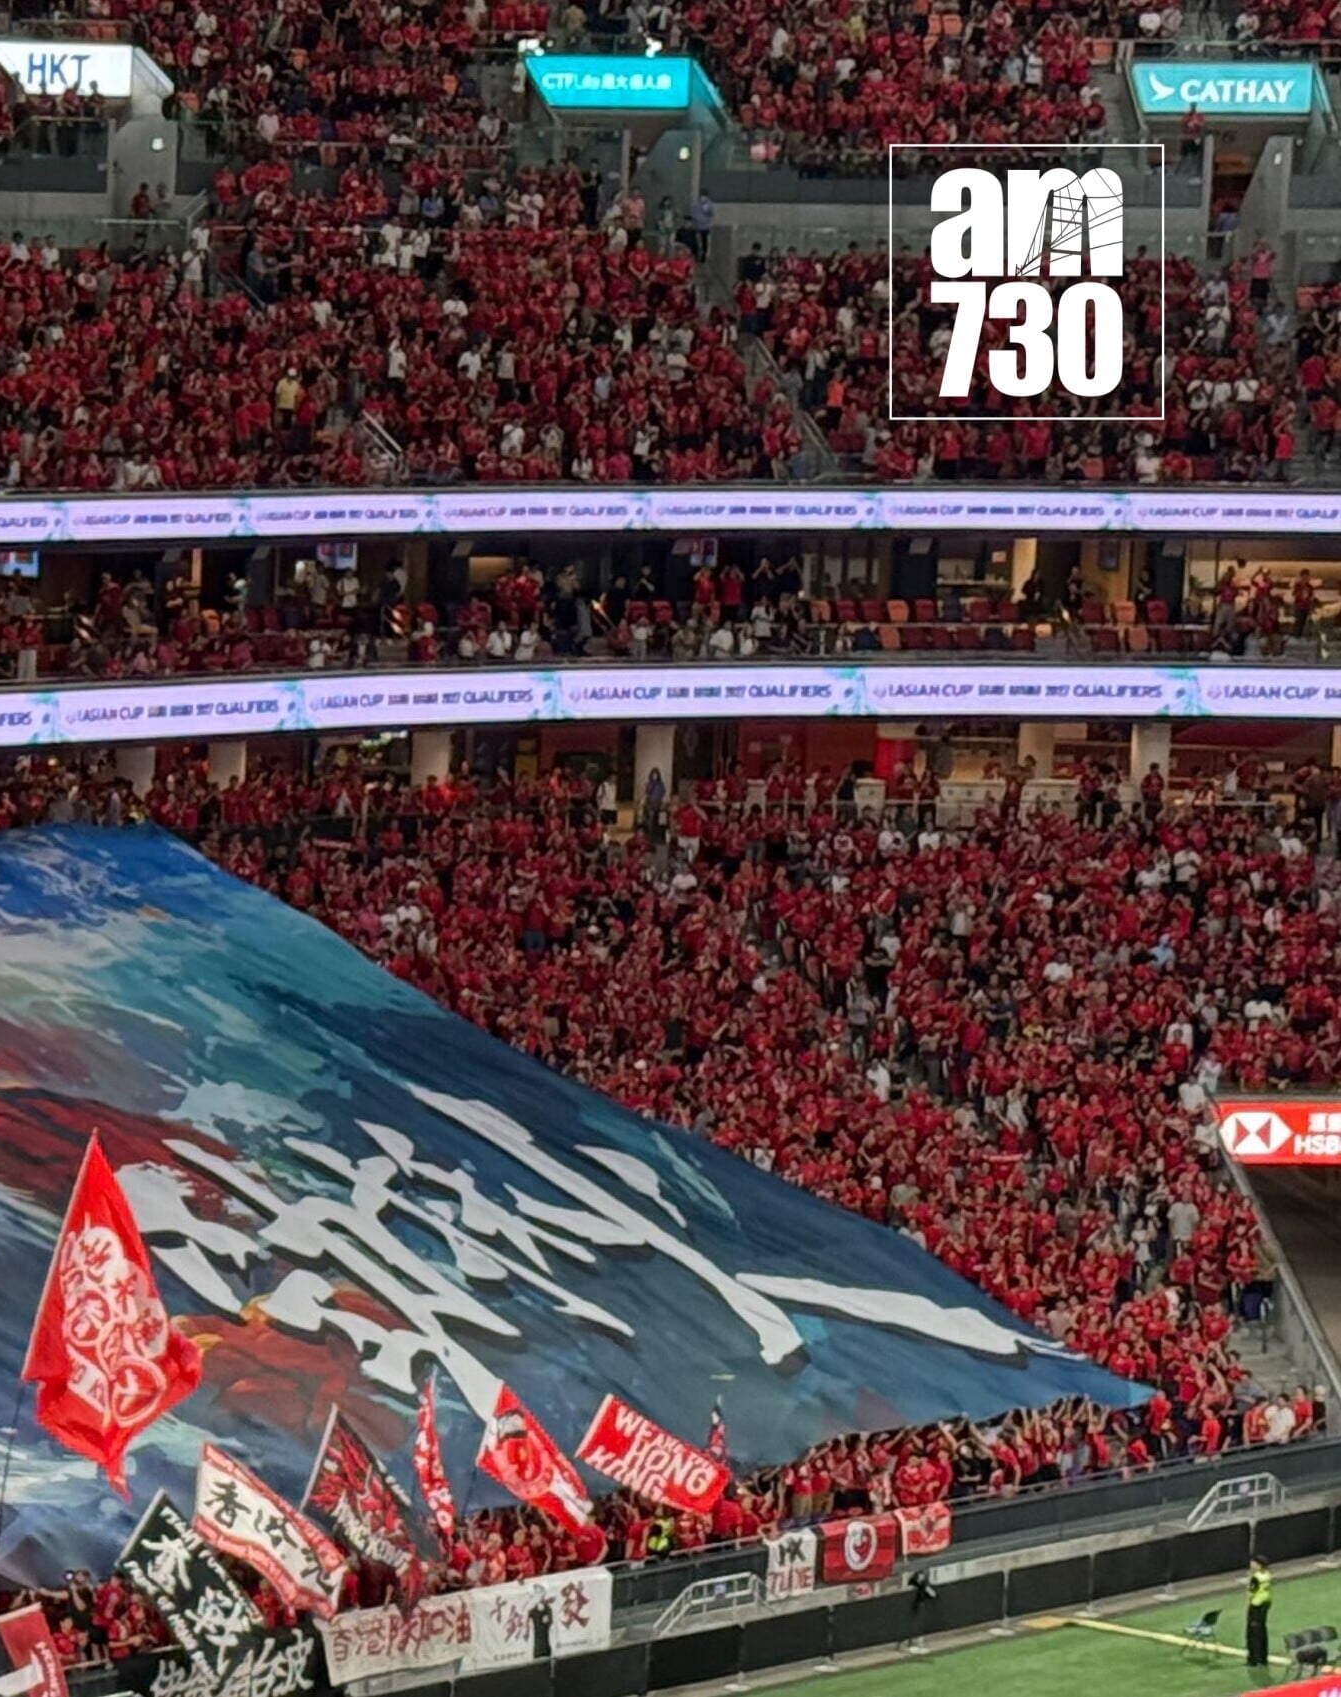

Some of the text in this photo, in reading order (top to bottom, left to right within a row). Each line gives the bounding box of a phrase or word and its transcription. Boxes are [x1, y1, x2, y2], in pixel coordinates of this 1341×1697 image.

[28, 53, 91, 85] HKT
[1180, 79, 1294, 103] CATHAY
[614, 1404, 655, 1441] WE
[625, 1440, 717, 1496] HONG
